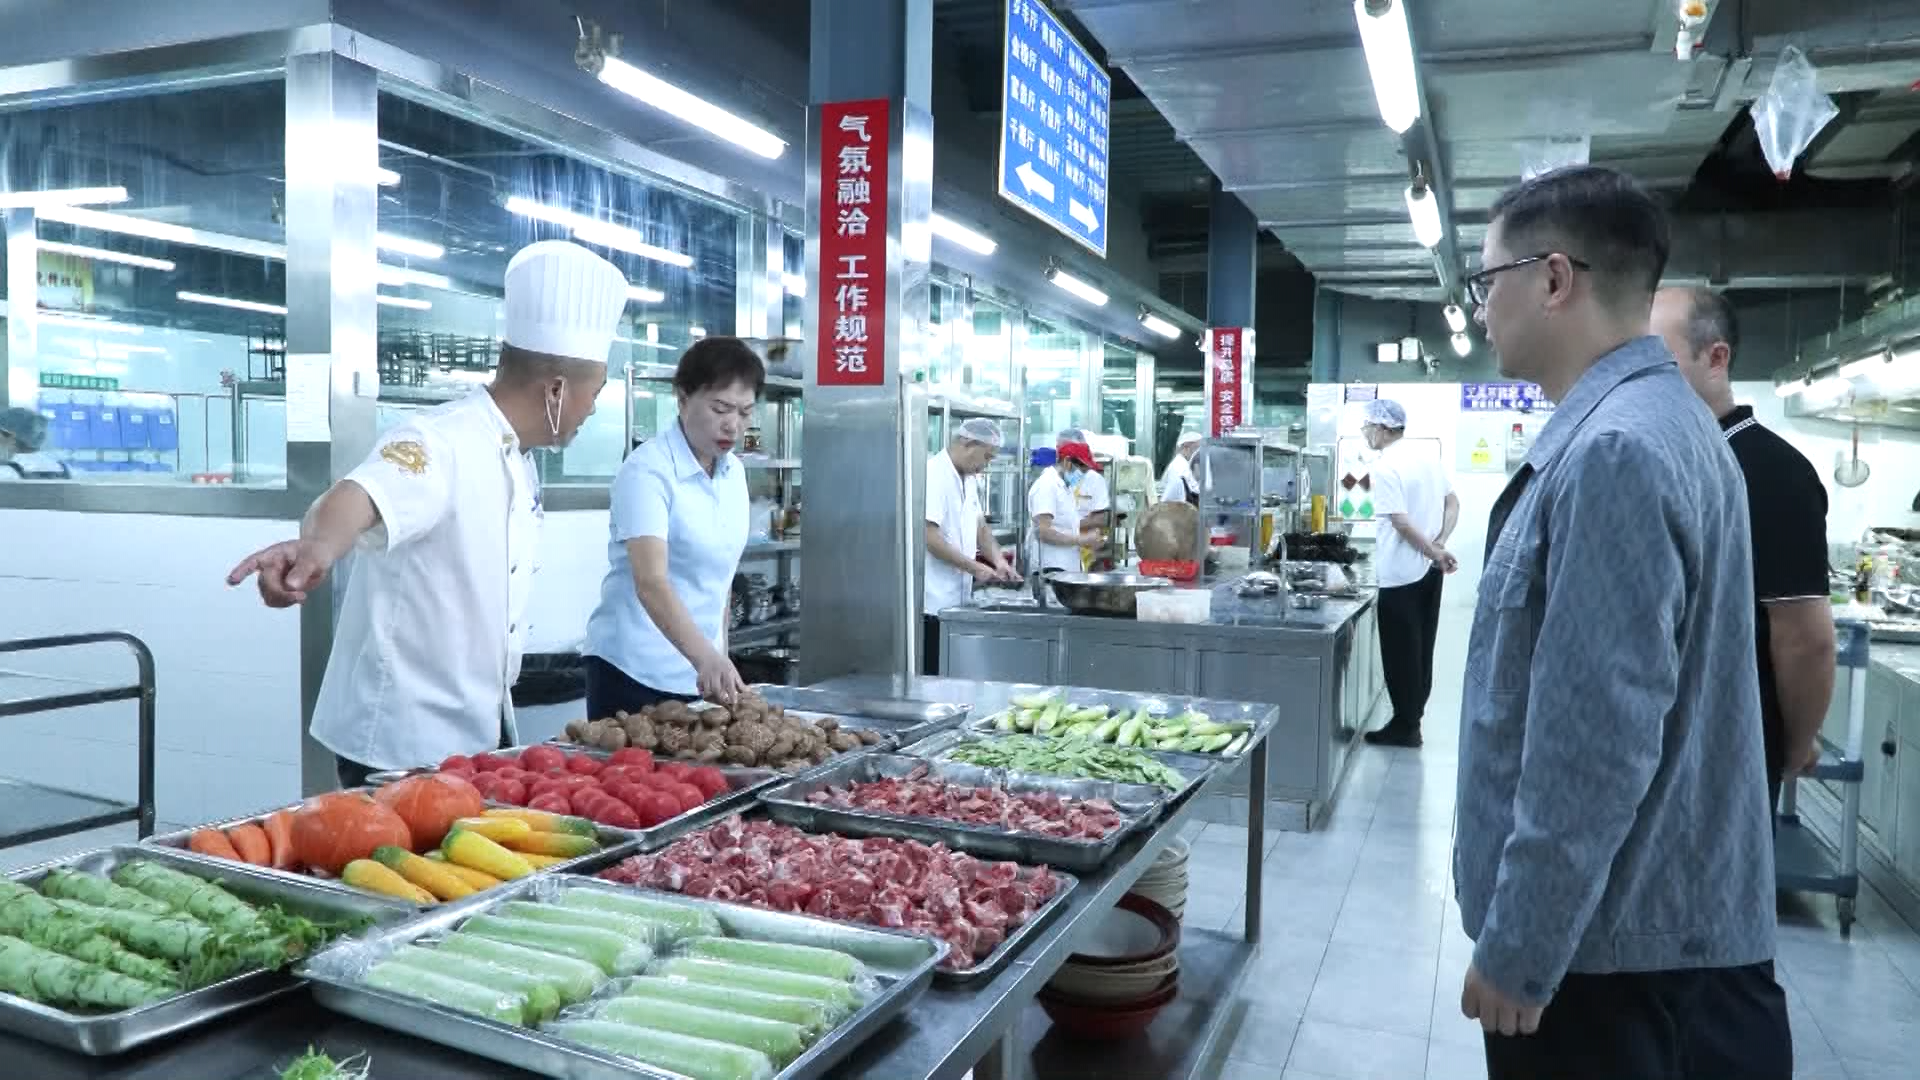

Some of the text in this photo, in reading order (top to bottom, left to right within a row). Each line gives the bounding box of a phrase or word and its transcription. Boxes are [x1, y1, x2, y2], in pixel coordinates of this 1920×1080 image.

[835, 115, 872, 373] 气氛融洽 工作规范
